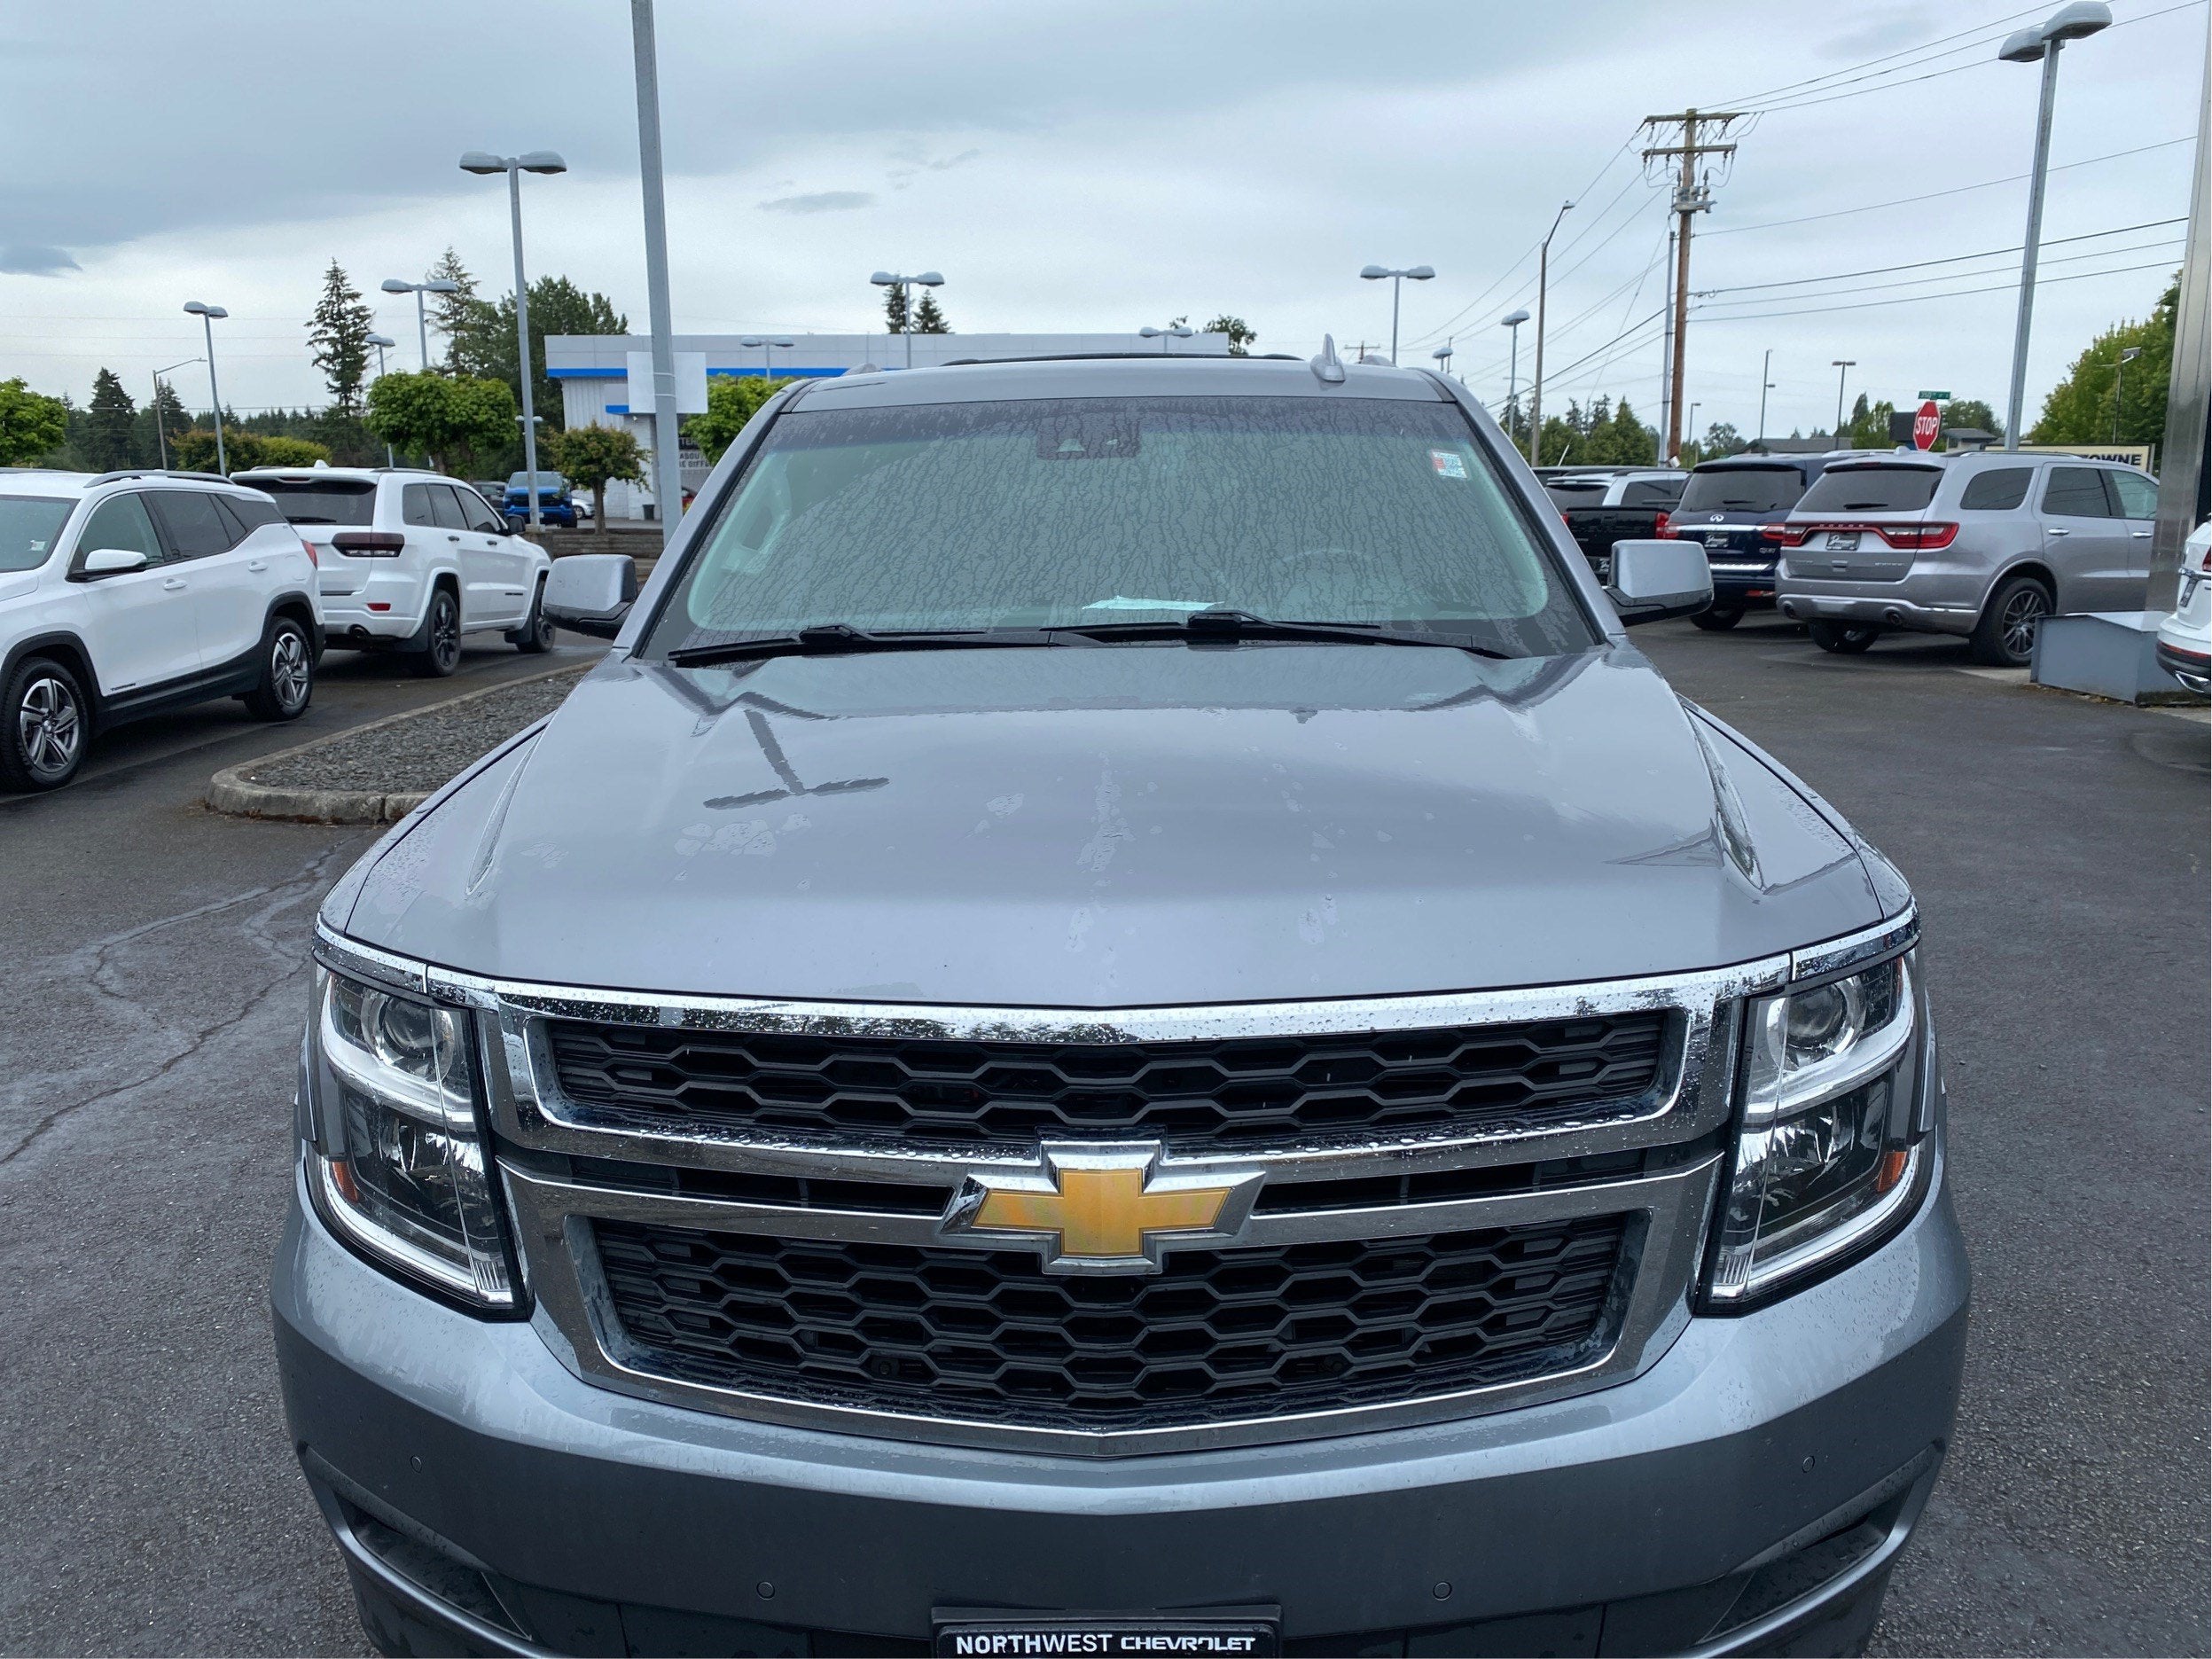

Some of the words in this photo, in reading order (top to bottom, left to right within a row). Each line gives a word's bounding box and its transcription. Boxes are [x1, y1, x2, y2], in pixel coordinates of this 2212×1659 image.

[1916, 417, 1938, 434] STOP
[2080, 454, 2142, 466] OWNE
[957, 1633, 1113, 1655] NORTHWEST
[1121, 1636, 1256, 1651] CHEVROLET
